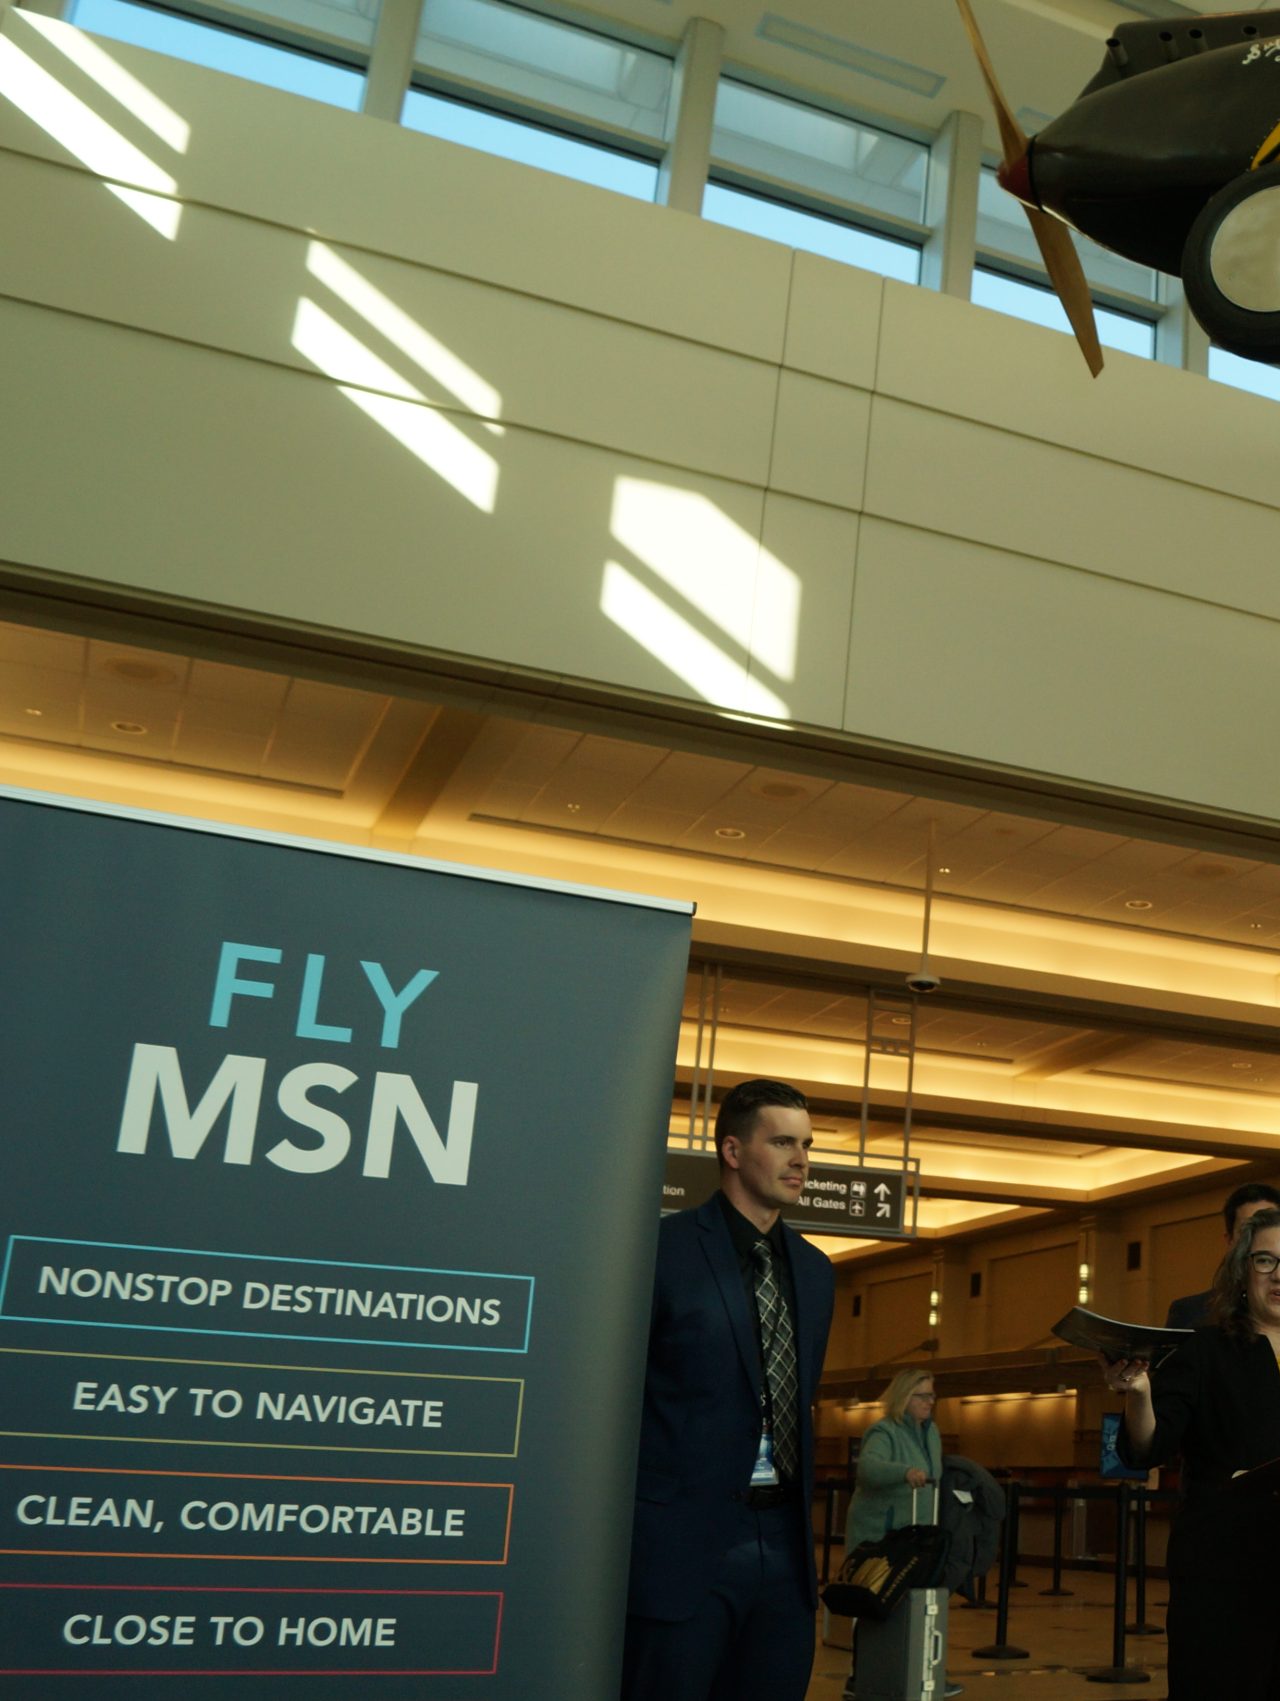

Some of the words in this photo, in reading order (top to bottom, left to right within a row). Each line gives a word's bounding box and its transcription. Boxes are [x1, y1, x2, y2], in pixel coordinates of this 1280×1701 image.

[210, 942, 439, 1048] FLY
[116, 1043, 478, 1185] MSN
[804, 1179, 847, 1195] icketing
[813, 1197, 846, 1210] Gates
[38, 1266, 232, 1306] NONSTOP
[242, 1282, 501, 1326] DESTINATIONS
[73, 1381, 178, 1415] EASY
[189, 1389, 243, 1418] TO
[256, 1392, 444, 1428] NAVIGATE
[17, 1494, 164, 1534] CLEAN,
[180, 1501, 466, 1537] COMFORTABLE
[63, 1614, 196, 1646] CLOSE
[210, 1616, 264, 1645] TO
[278, 1617, 397, 1647] HOME
